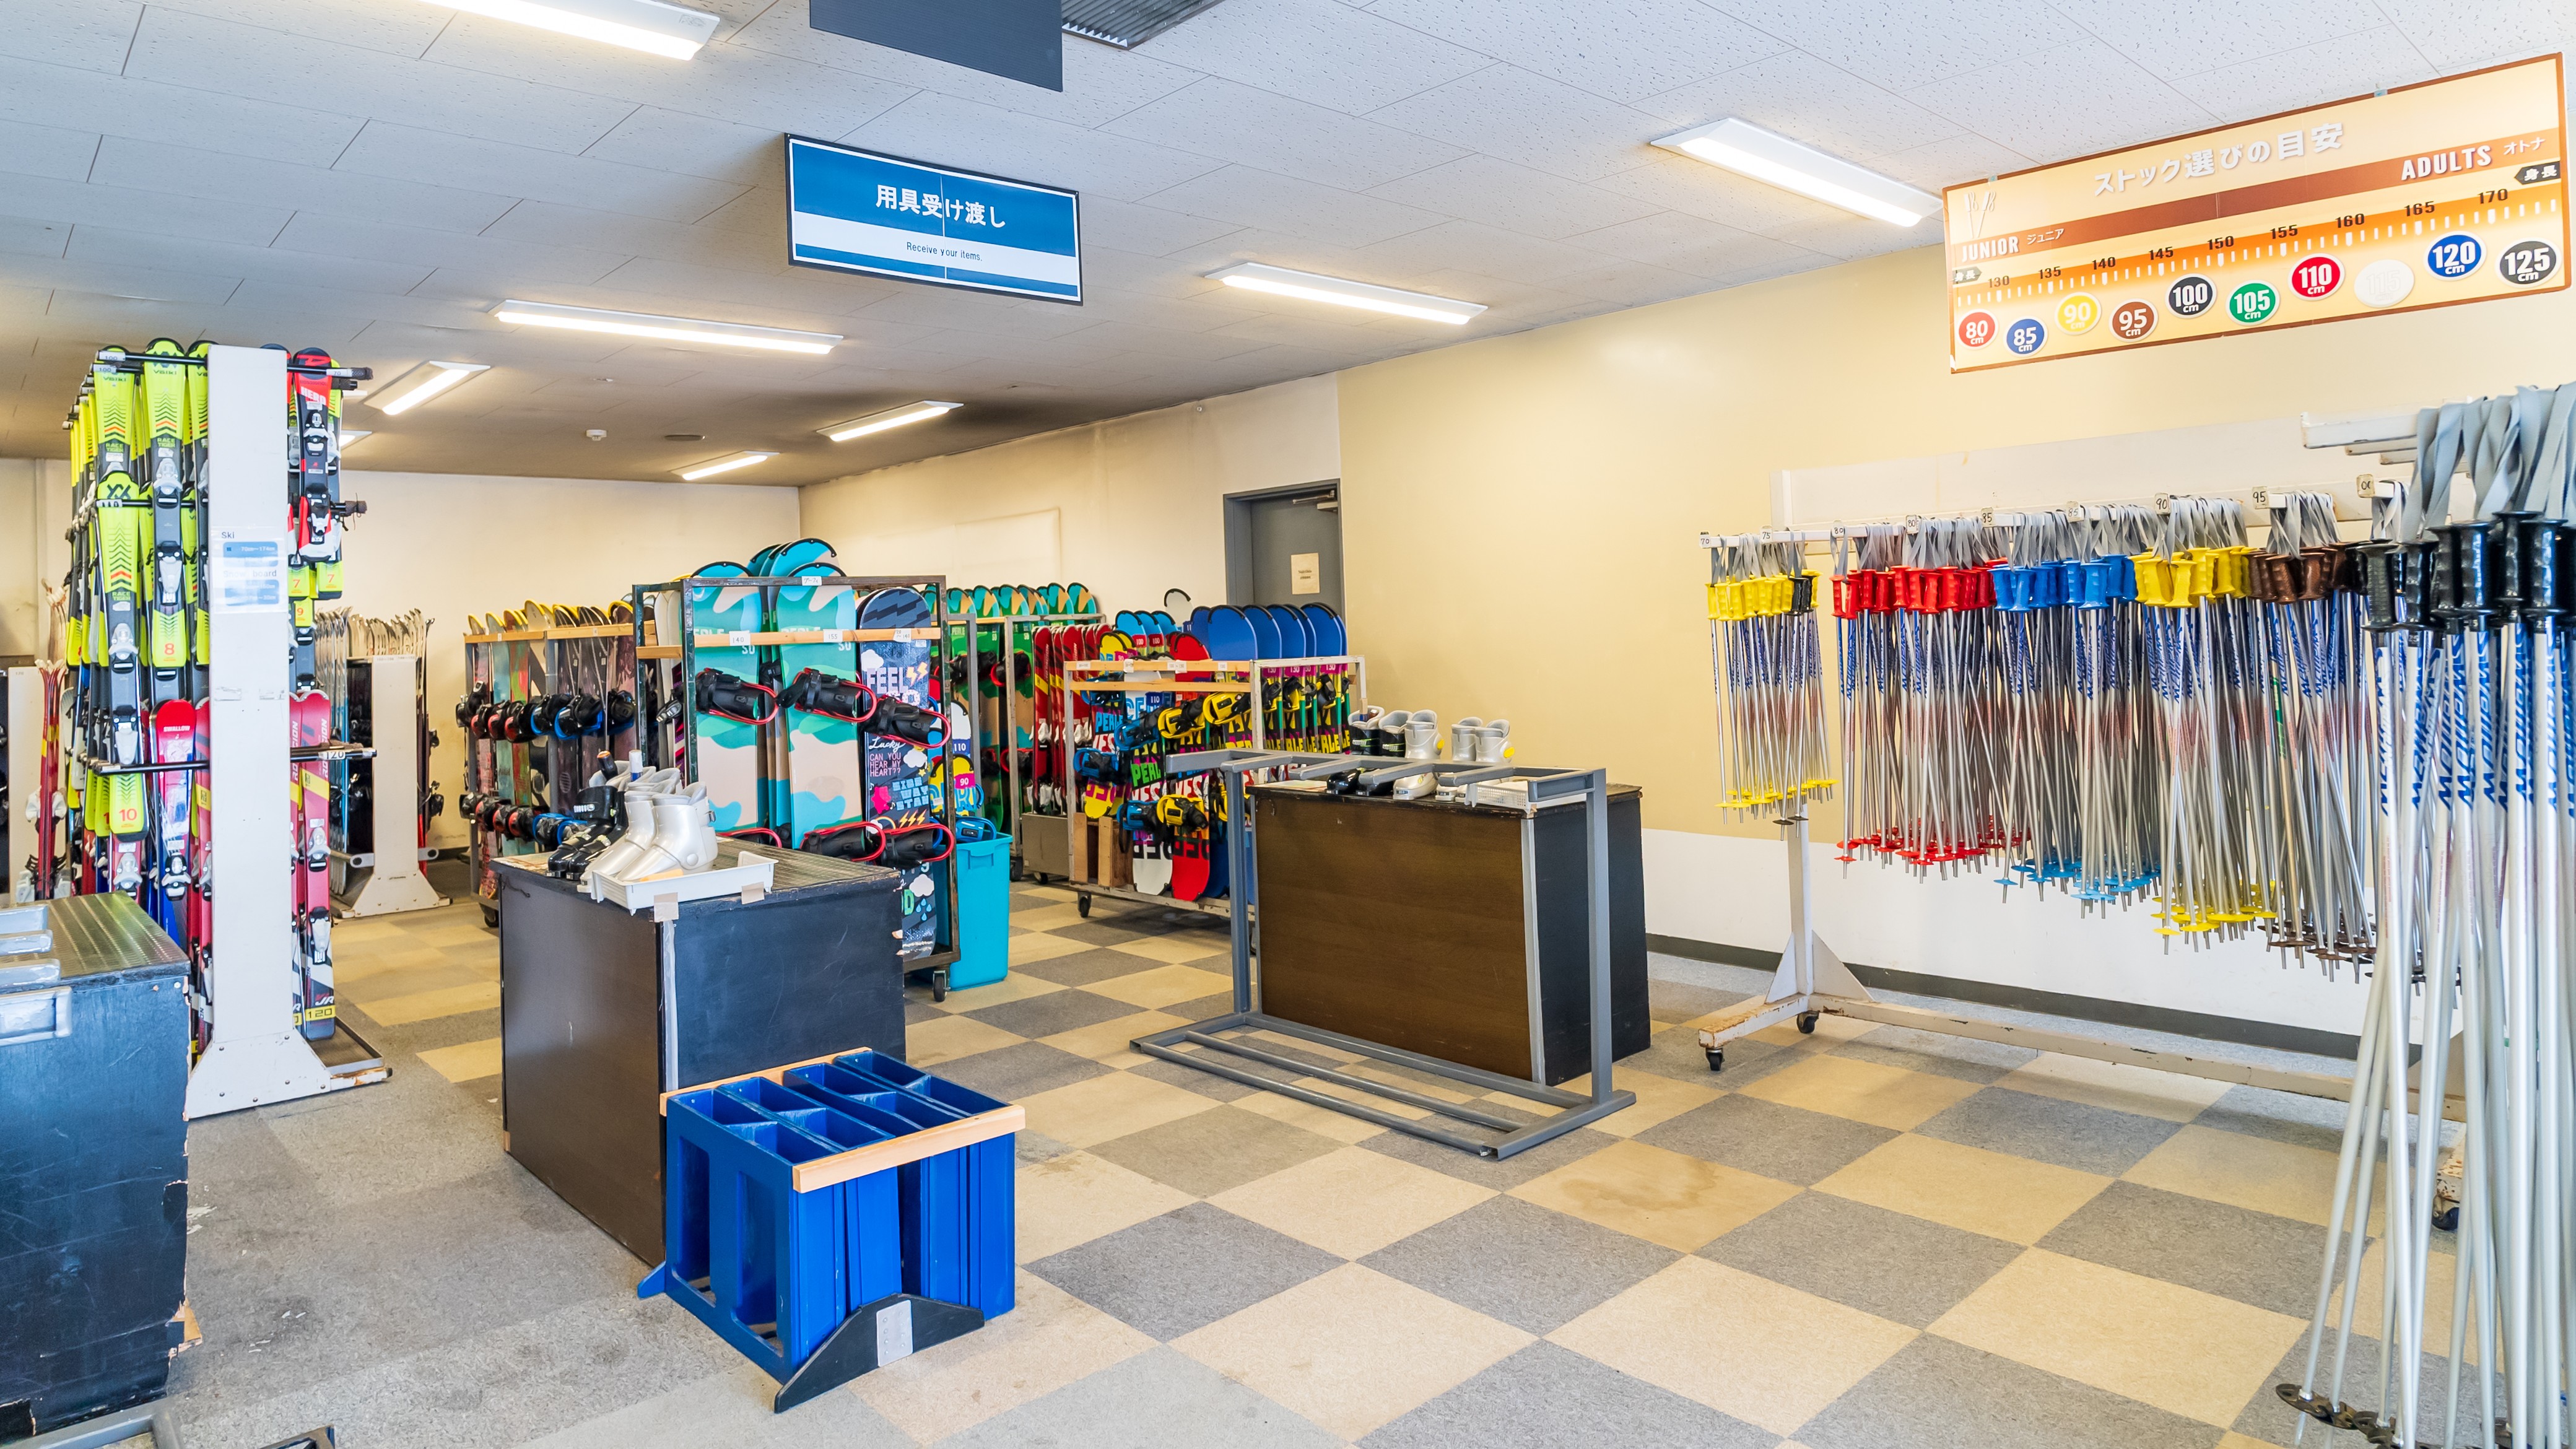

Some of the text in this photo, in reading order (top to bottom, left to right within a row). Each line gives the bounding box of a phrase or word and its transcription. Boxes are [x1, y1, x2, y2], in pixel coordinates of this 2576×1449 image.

[2503, 137, 2545, 155] オトナ
[2094, 122, 2343, 196] ストック選びの目安
[2401, 146, 2491, 181] ADULTS
[2524, 165, 2557, 181] 身長
[876, 185, 1006, 228] 用具受け渡し
[1988, 189, 2508, 288] 130 135 140 145 150 155 160 165 170
[2027, 228, 2065, 245] ジュニア
[906, 242, 983, 261] Receive your items.
[1962, 236, 2019, 262] JUNIOR
[2433, 241, 2476, 268] 120
[2504, 248, 2550, 276] 125
[2445, 264, 2465, 275] cm
[2299, 264, 2332, 289] 110
[2365, 270, 2400, 295] 115
[2517, 271, 2539, 282] cm
[2172, 283, 2208, 308] 100
[2307, 285, 2325, 295] cm
[2183, 303, 2199, 312] cm
[2234, 290, 2270, 314] 105
[2064, 302, 2091, 323] 90
[2244, 310, 2261, 320] cm
[2071, 321, 2085, 329] cm
[2119, 308, 2147, 331] 95
[1966, 320, 1988, 338] 80
[2126, 328, 2141, 336] cm
[2014, 327, 2037, 346] 85
[2019, 343, 2032, 352] cm
[2253, 491, 2266, 503] 95
[2156, 498, 2167, 510] 90
[1982, 513, 1993, 523] 85
[2068, 508, 2079, 518] 85
[1908, 520, 1916, 528] 80
[1762, 531, 1771, 539] 75
[293, 579, 300, 588] 7
[328, 574, 335, 583] 7
[297, 607, 304, 616] 9
[164, 643, 175, 656] 8
[867, 666, 909, 694] FEEL
[1151, 695, 1160, 703] 110
[869, 736, 906, 753] Lucky
[954, 743, 967, 752] 110
[869, 752, 902, 761] CAN YOU
[869, 761, 888, 769] HEAR
[869, 768, 902, 777] HEART??
[960, 778, 969, 786] 90
[900, 785, 928, 800] WAY
[119, 808, 137, 822] 10
[315, 996, 334, 1006] JR
[308, 1008, 333, 1019] 120
